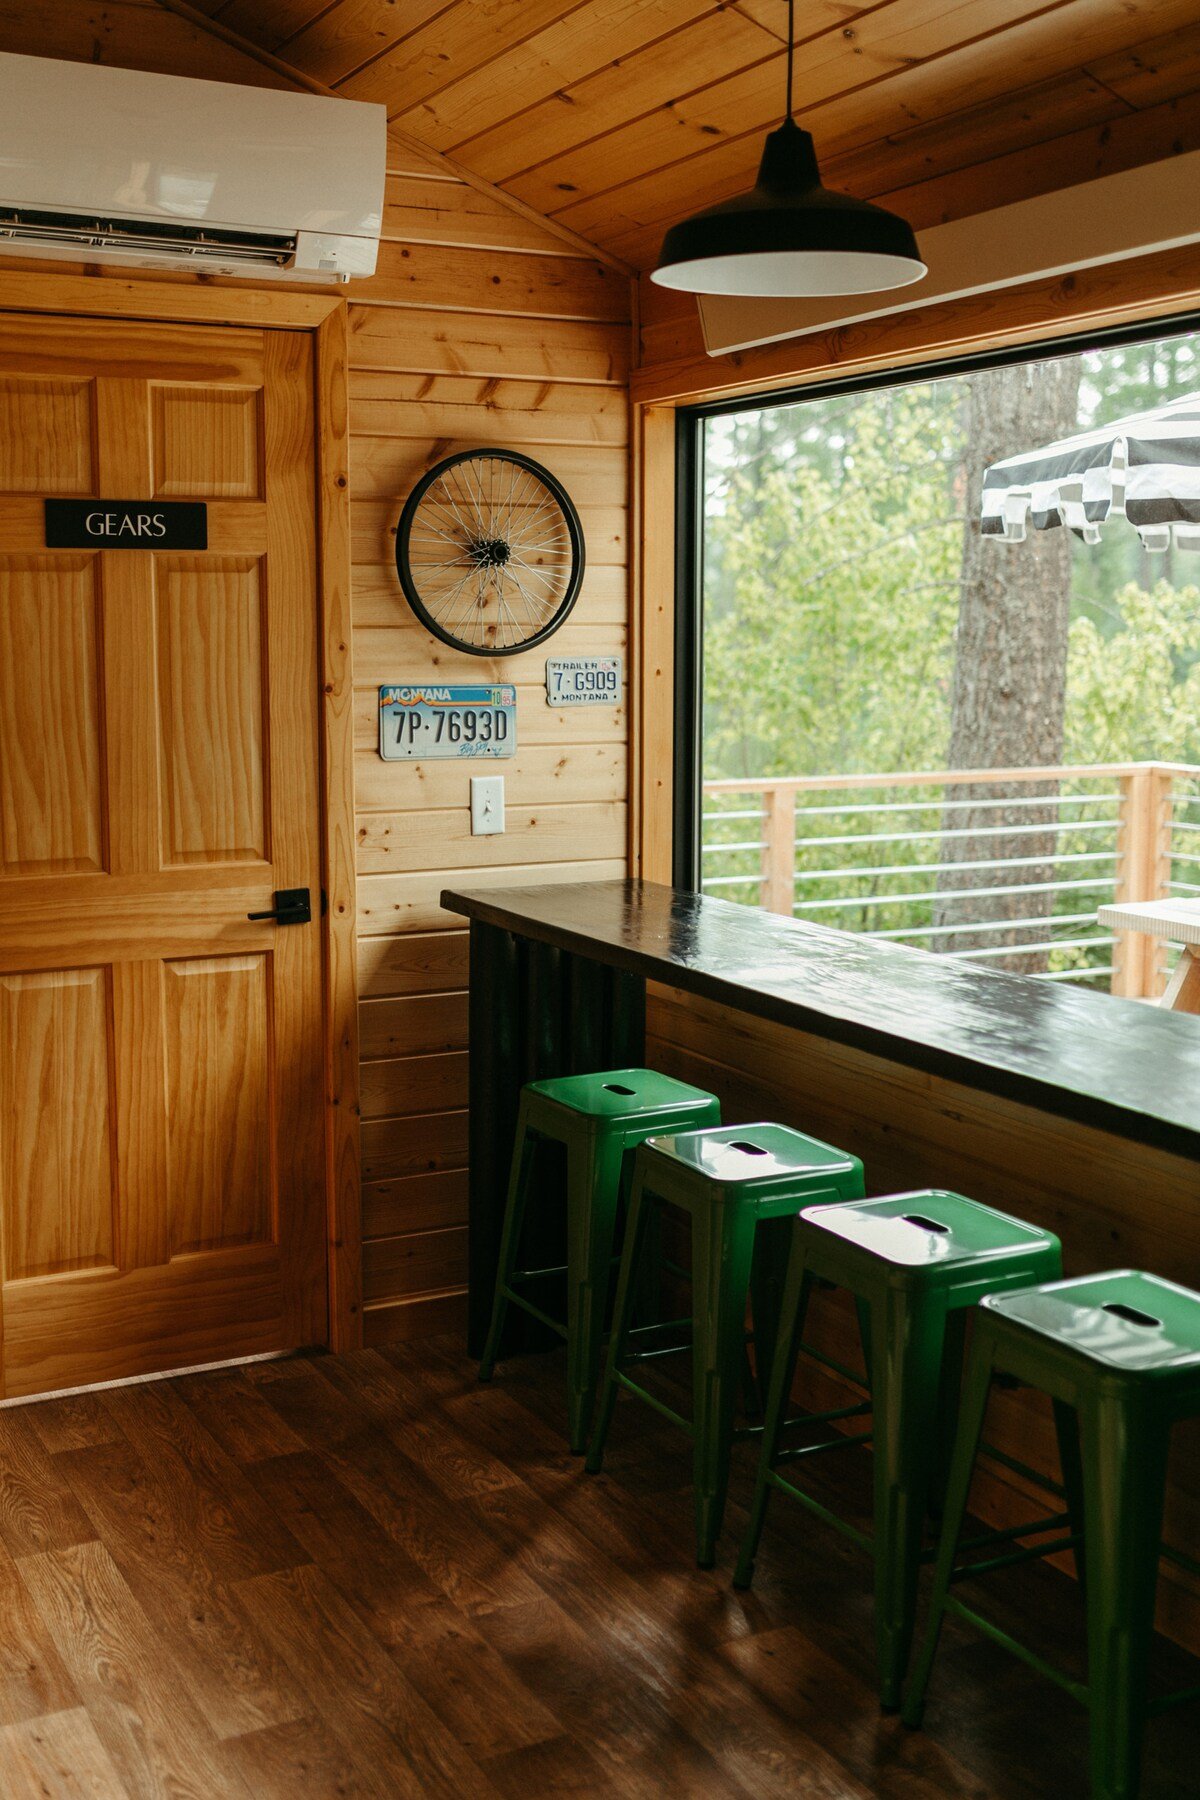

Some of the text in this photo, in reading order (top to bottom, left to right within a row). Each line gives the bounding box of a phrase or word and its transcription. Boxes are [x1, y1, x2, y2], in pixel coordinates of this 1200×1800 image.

[85, 512, 166, 537] GEARS
[556, 662, 598, 670] TRAILER
[388, 687, 452, 701] MONTANA
[561, 693, 609, 701] MONTANA
